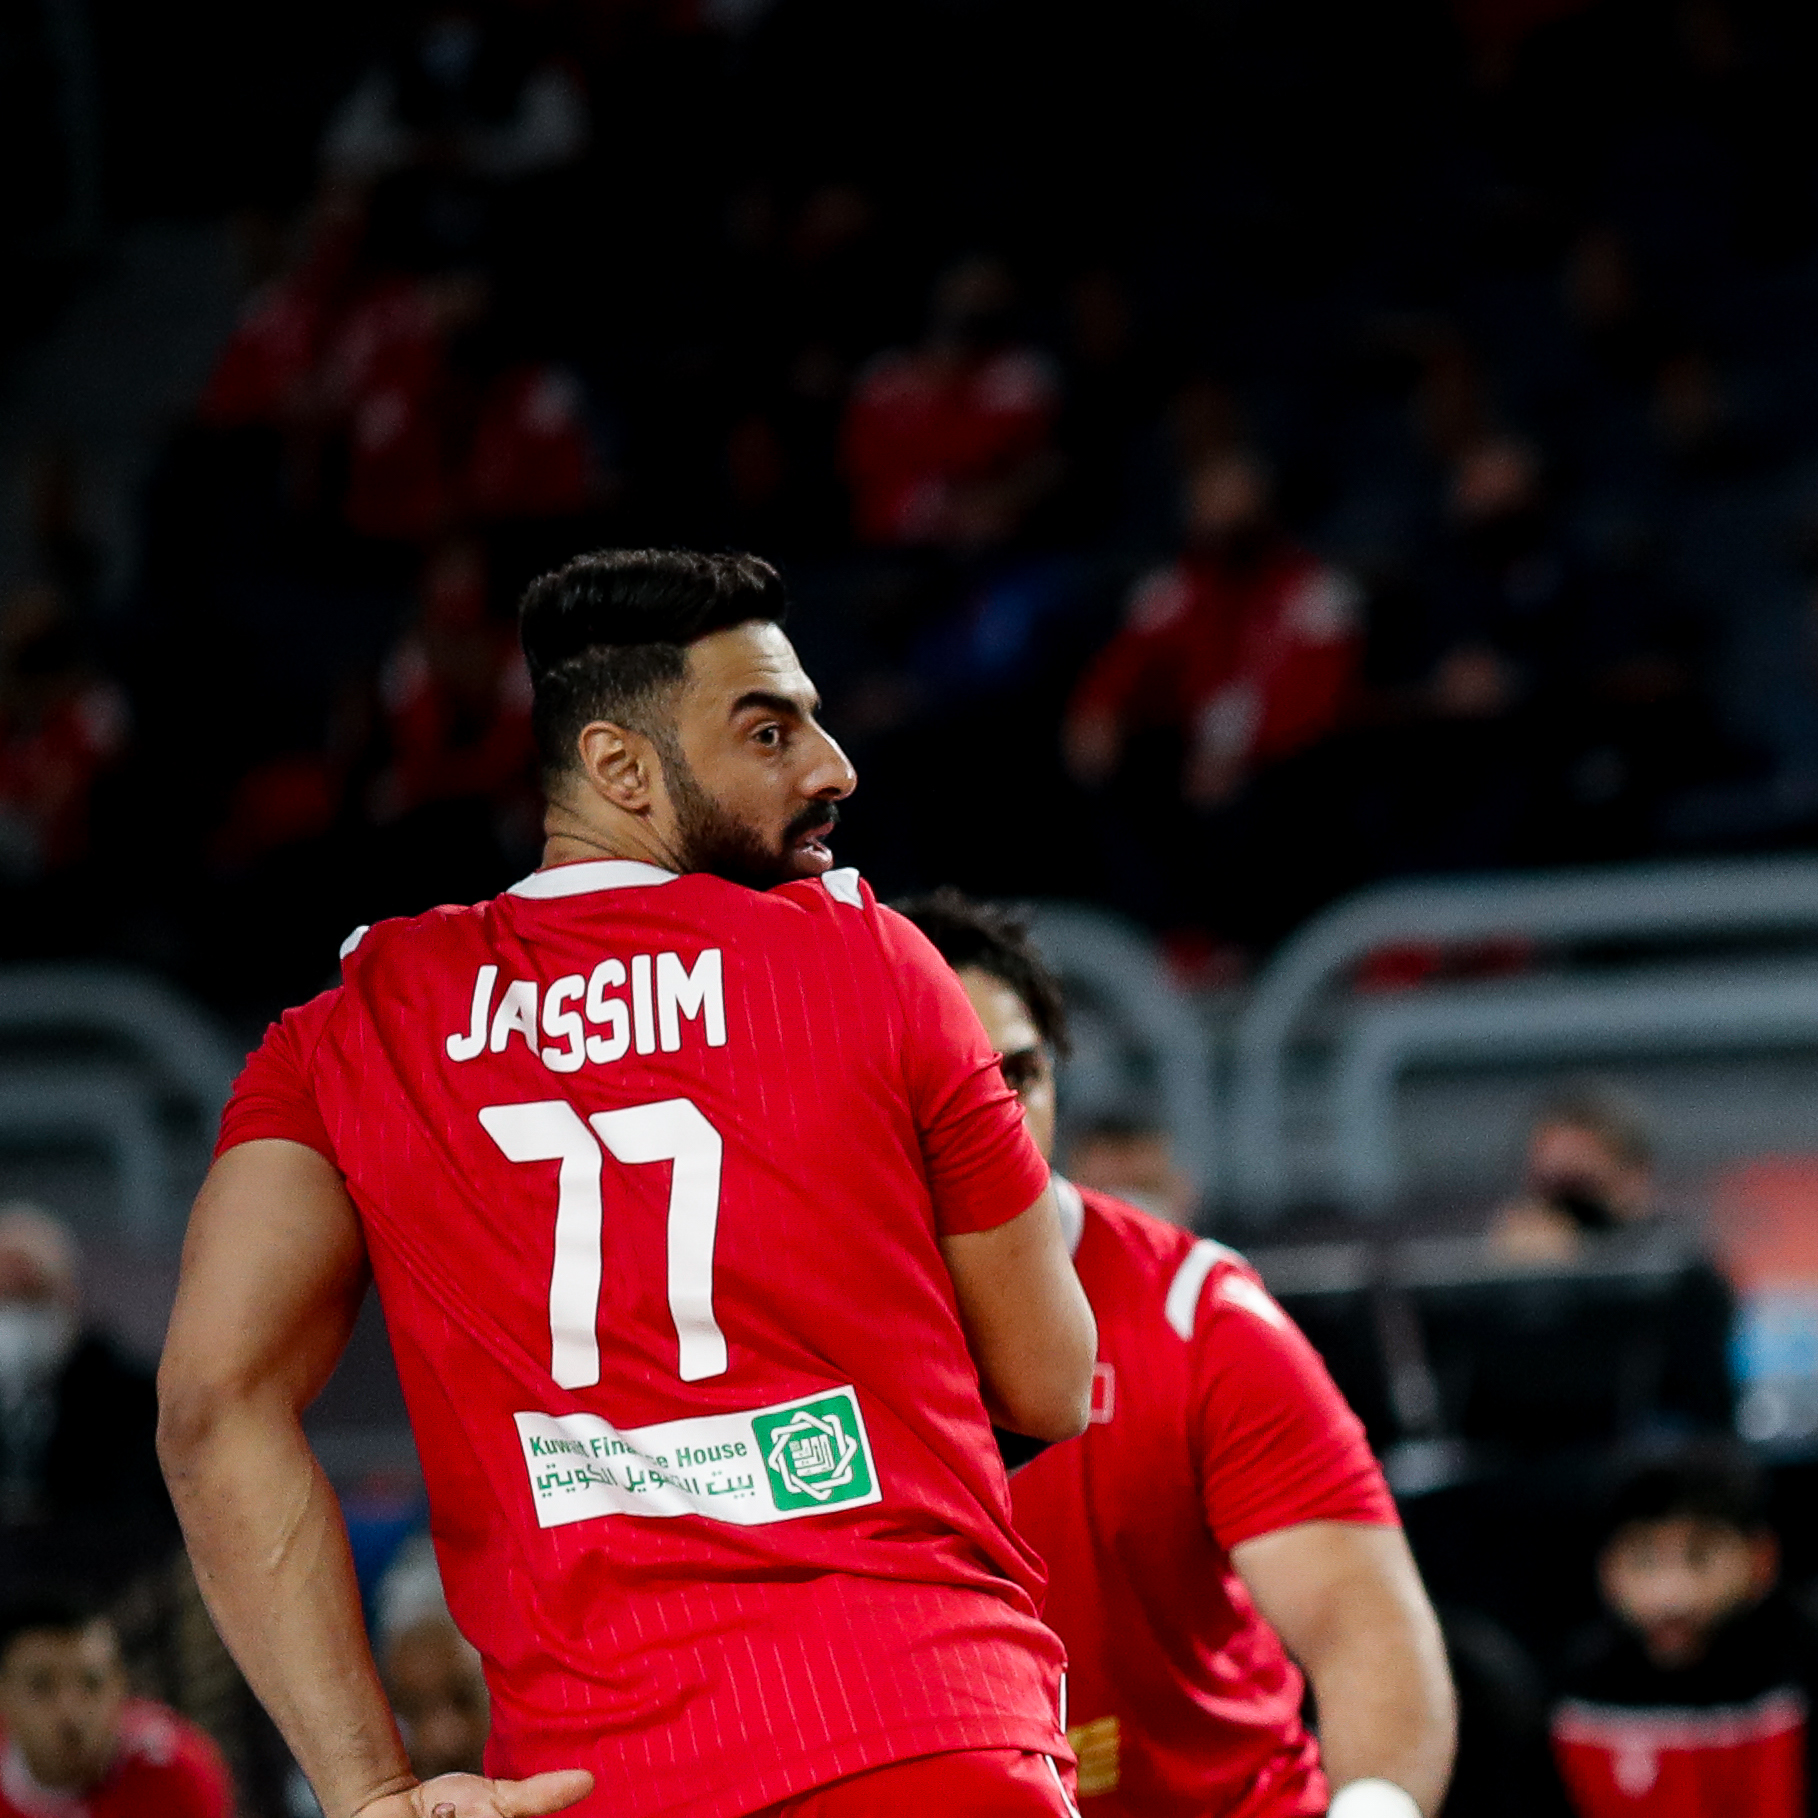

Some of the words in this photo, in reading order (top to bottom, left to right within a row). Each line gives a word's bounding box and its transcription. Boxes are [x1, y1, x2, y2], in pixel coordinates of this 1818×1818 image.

[445, 948, 727, 1073] JASSIM
[477, 1098, 728, 1390] 77
[590, 1436, 669, 1469] Finae
[677, 1438, 748, 1469] House
[705, 1469, 756, 1500] بيت
